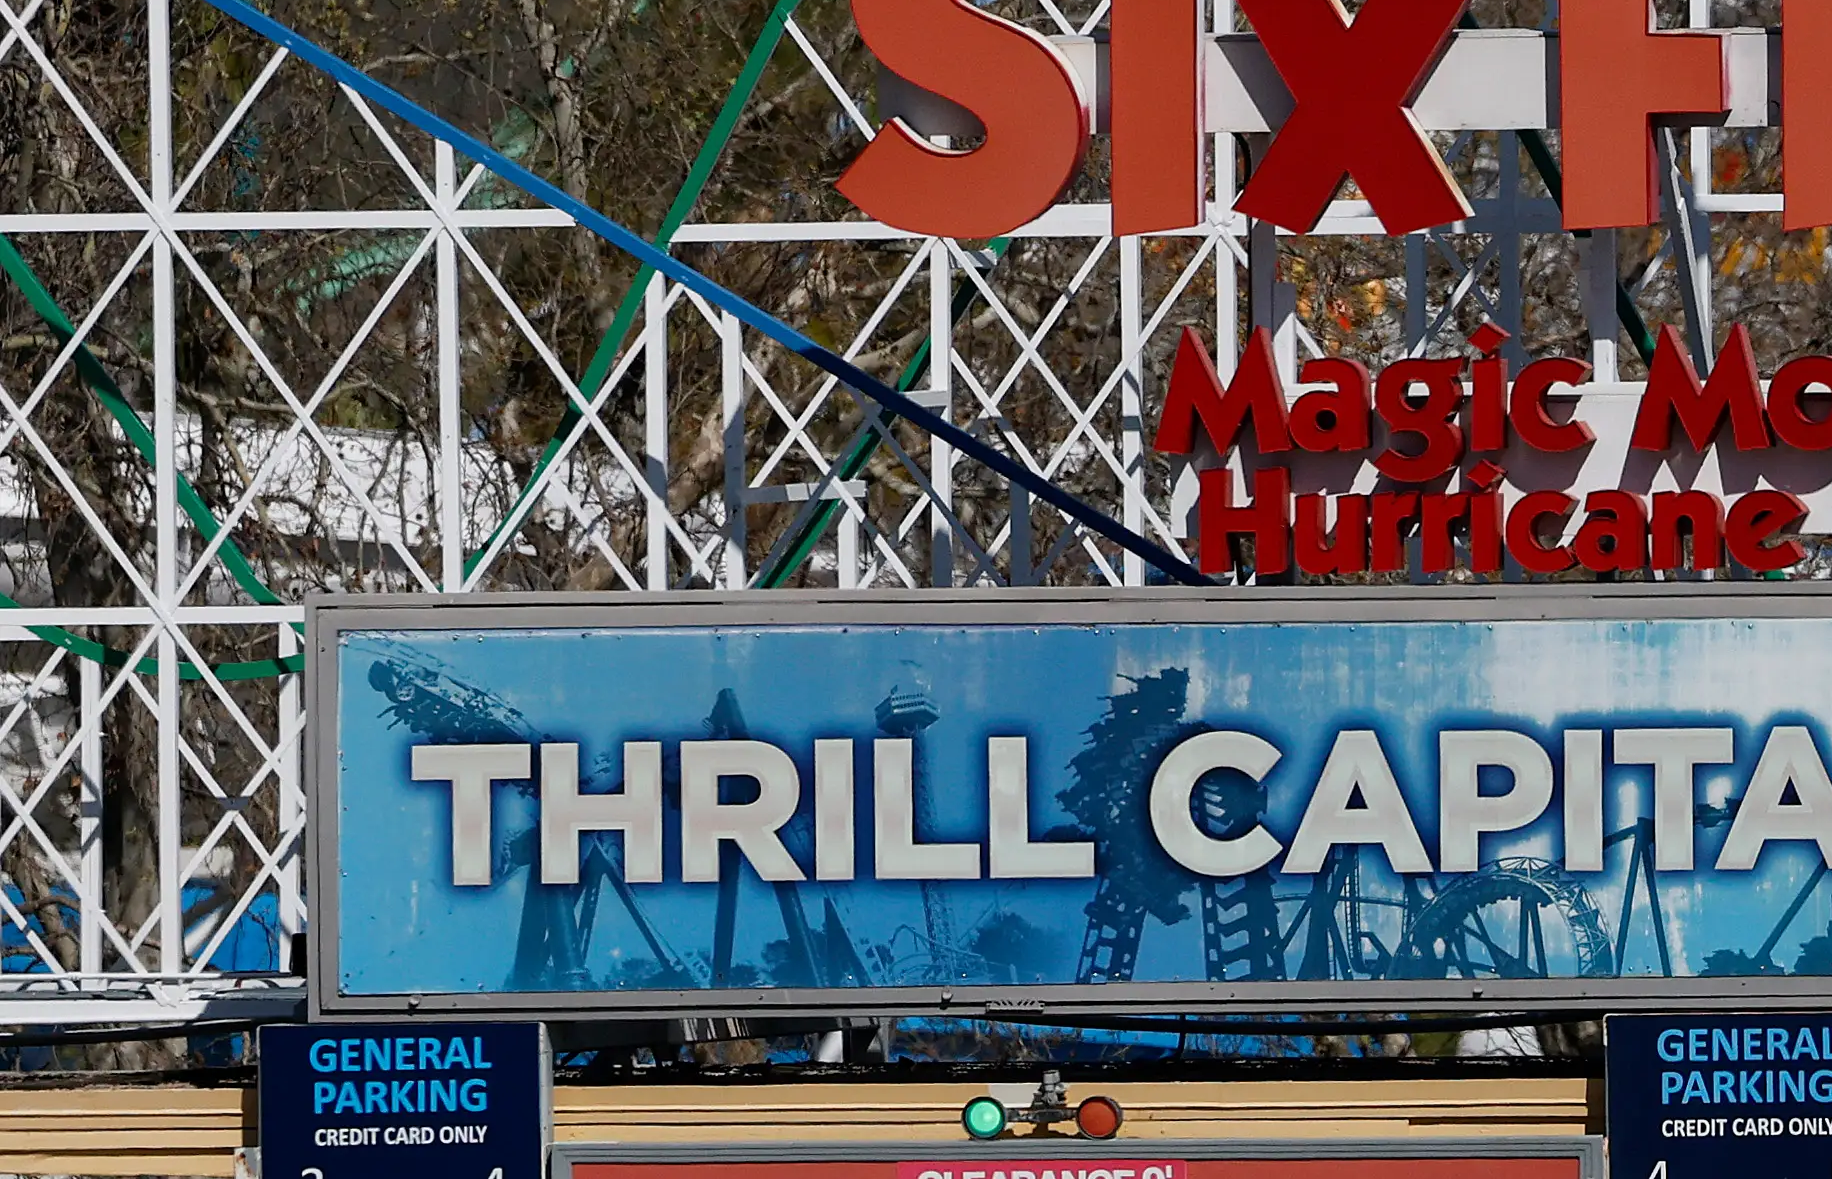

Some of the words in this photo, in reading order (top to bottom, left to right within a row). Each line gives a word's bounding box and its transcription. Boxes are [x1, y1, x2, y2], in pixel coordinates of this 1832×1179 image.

[1154, 323, 1597, 482] Magic
[1200, 459, 1809, 575] Hurricane
[411, 736, 1095, 887] THRILL
[308, 1036, 493, 1073] GENERAL
[313, 1078, 488, 1114] PARKING
[314, 1127, 381, 1147] CREDIT
[383, 1126, 435, 1146] CARD
[439, 1125, 488, 1144] ONLY
[1661, 1118, 1728, 1138] CREDIT
[1732, 1118, 1784, 1137] CARD
